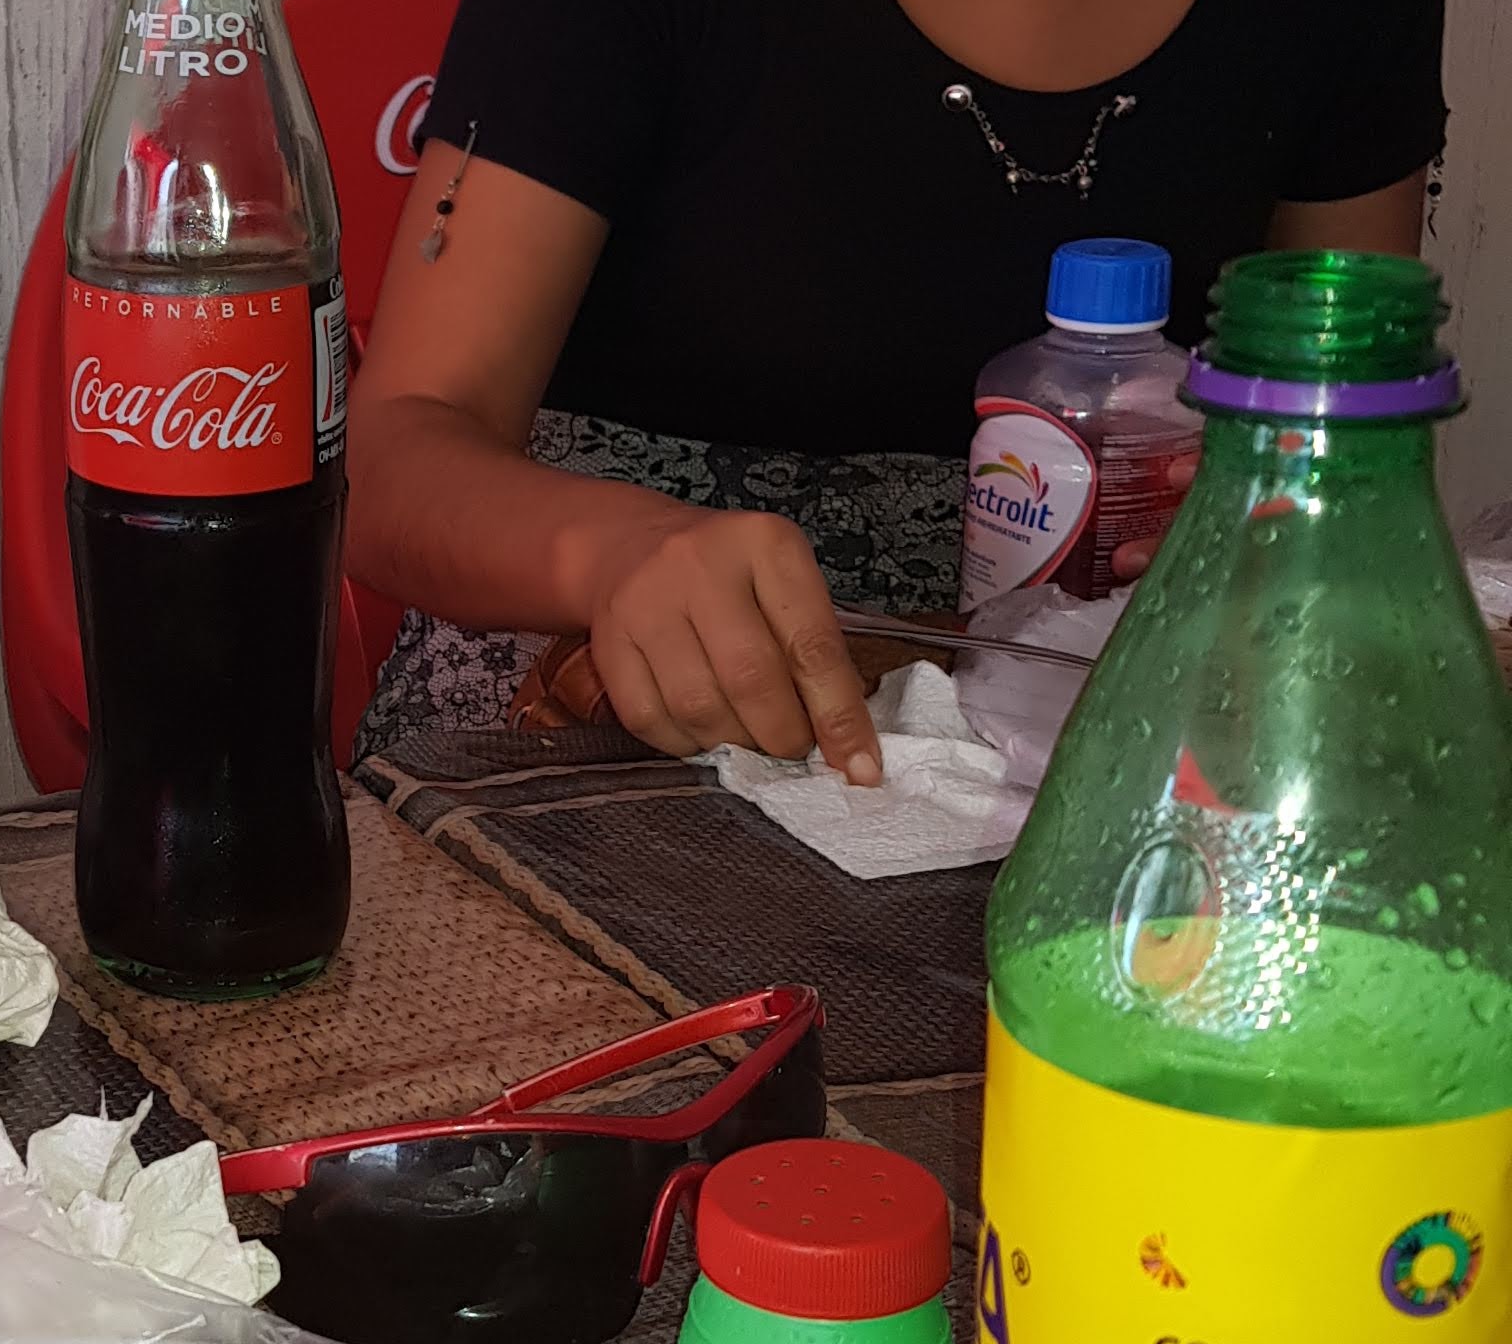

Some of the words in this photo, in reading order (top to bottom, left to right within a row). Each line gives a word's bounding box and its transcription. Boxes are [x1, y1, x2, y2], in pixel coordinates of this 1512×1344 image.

[125, 9, 246, 40] MEDIO
[119, 46, 249, 78] LITRO
[73, 287, 282, 319] RETORNABLE
[70, 356, 289, 451] Coca-Cola
